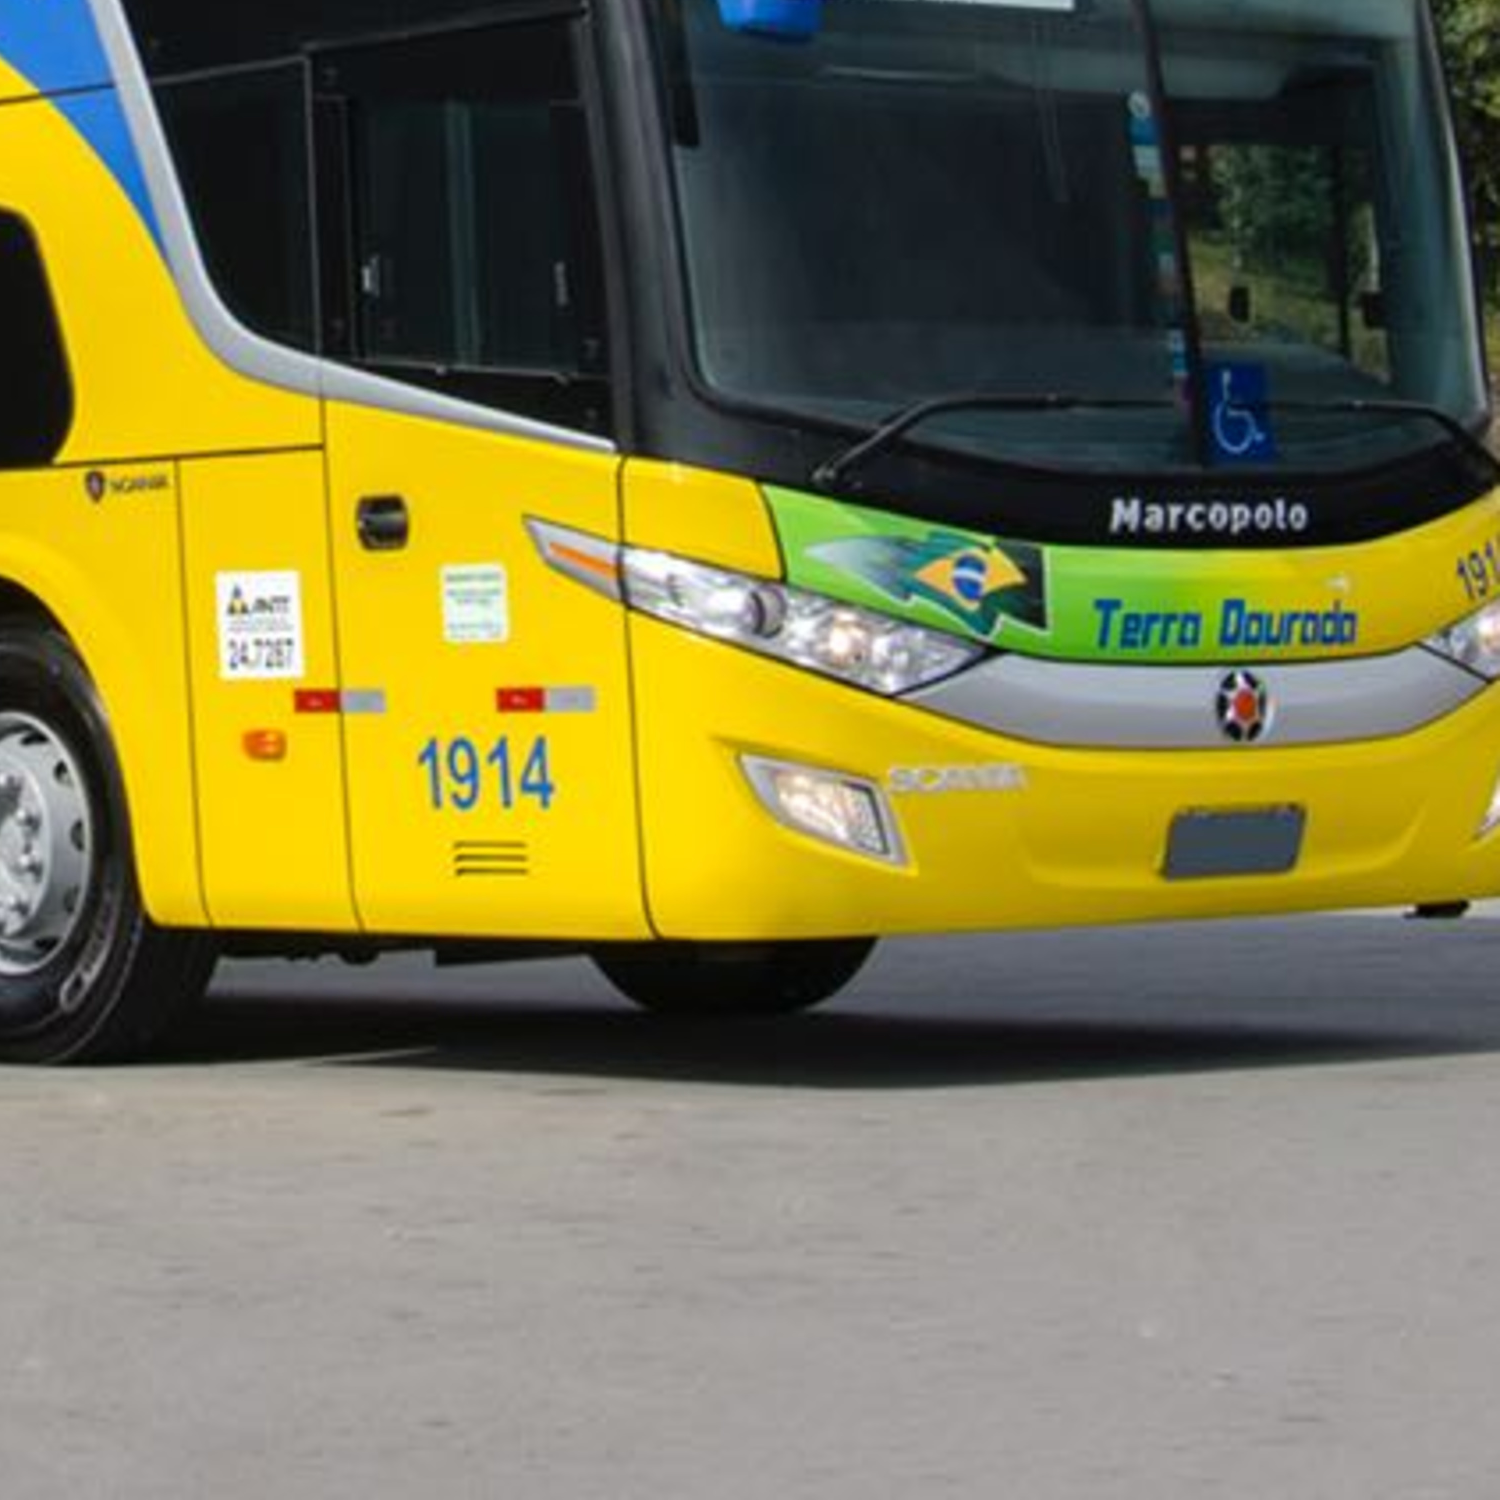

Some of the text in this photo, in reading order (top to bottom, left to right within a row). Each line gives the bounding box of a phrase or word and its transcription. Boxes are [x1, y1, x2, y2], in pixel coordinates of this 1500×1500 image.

[1110, 498, 1308, 536] Marcopolo
[1095, 598, 1358, 649] Terra Dourada
[417, 734, 555, 810] 1914
